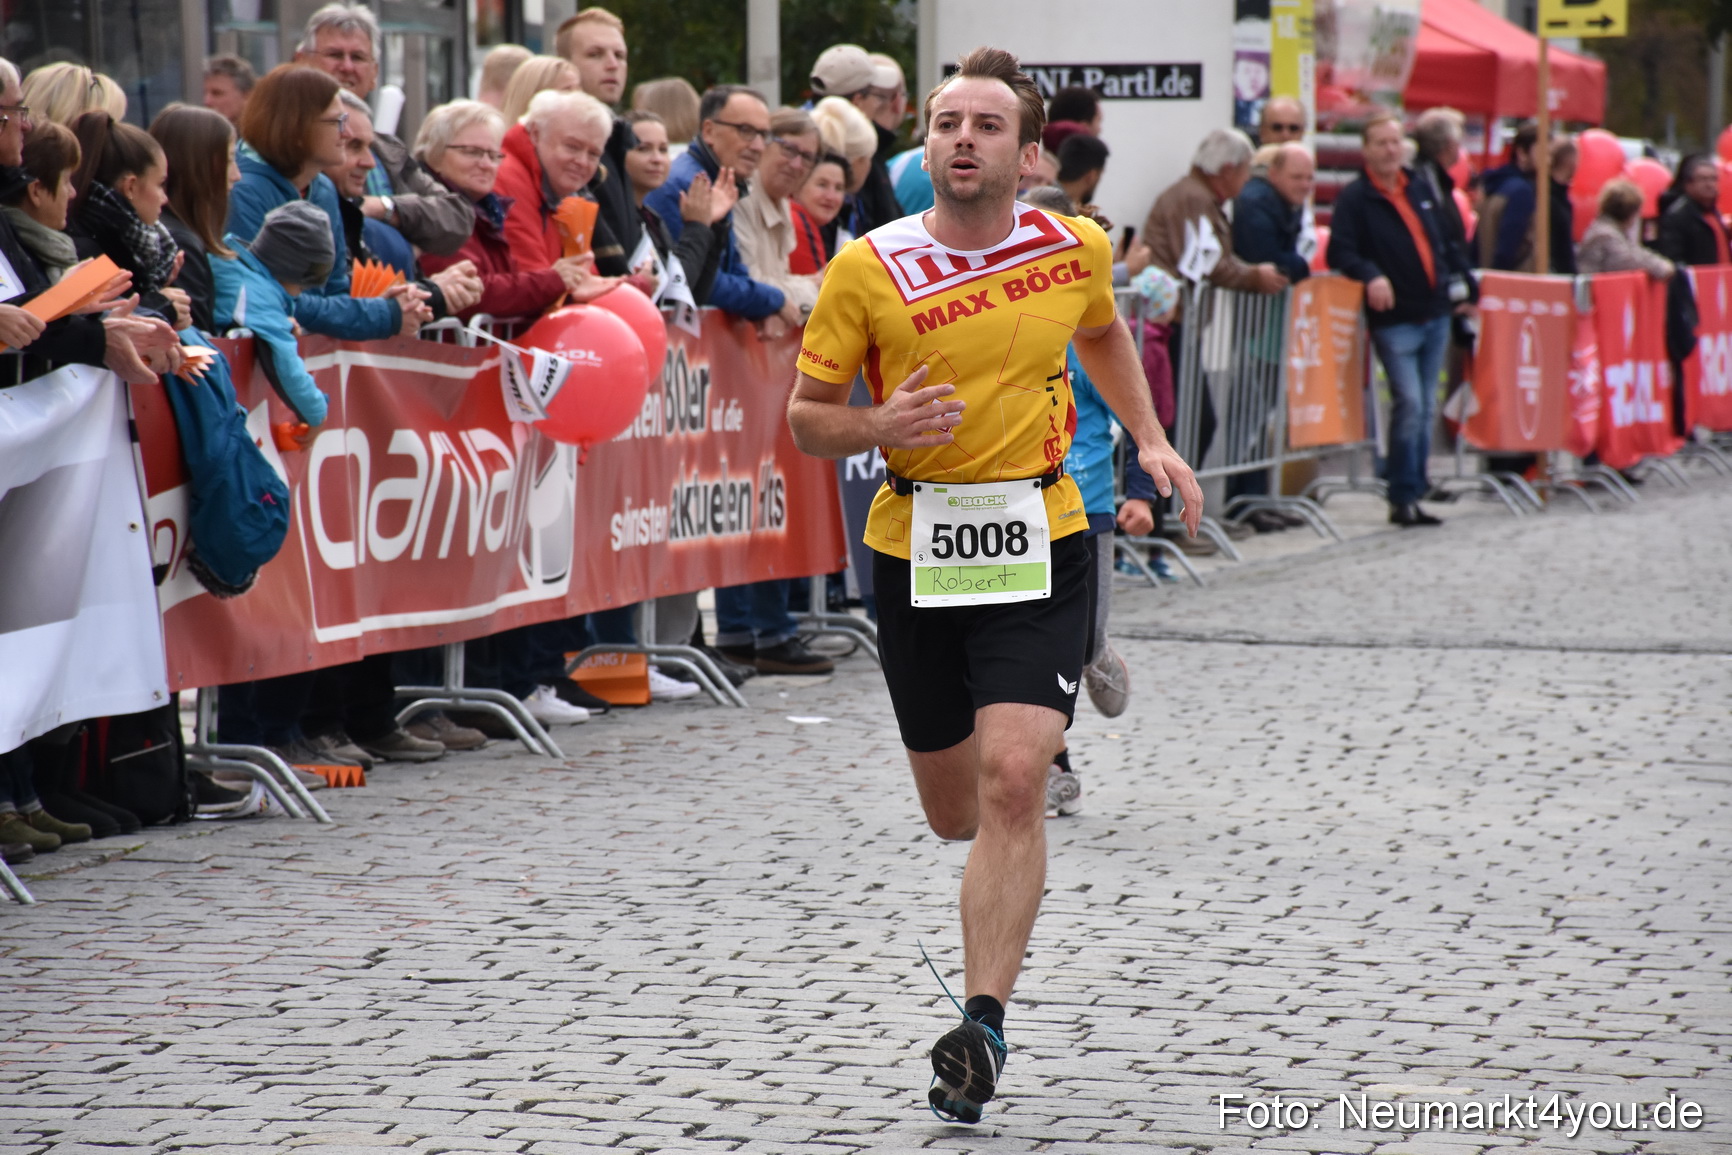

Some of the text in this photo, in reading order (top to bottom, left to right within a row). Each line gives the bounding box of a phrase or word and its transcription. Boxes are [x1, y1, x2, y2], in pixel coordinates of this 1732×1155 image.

[911, 258, 1092, 335] MAX BÖGL
[961, 494, 1008, 507] BOCK
[932, 521, 1028, 559] 5008
[928, 565, 1017, 592] Robert
